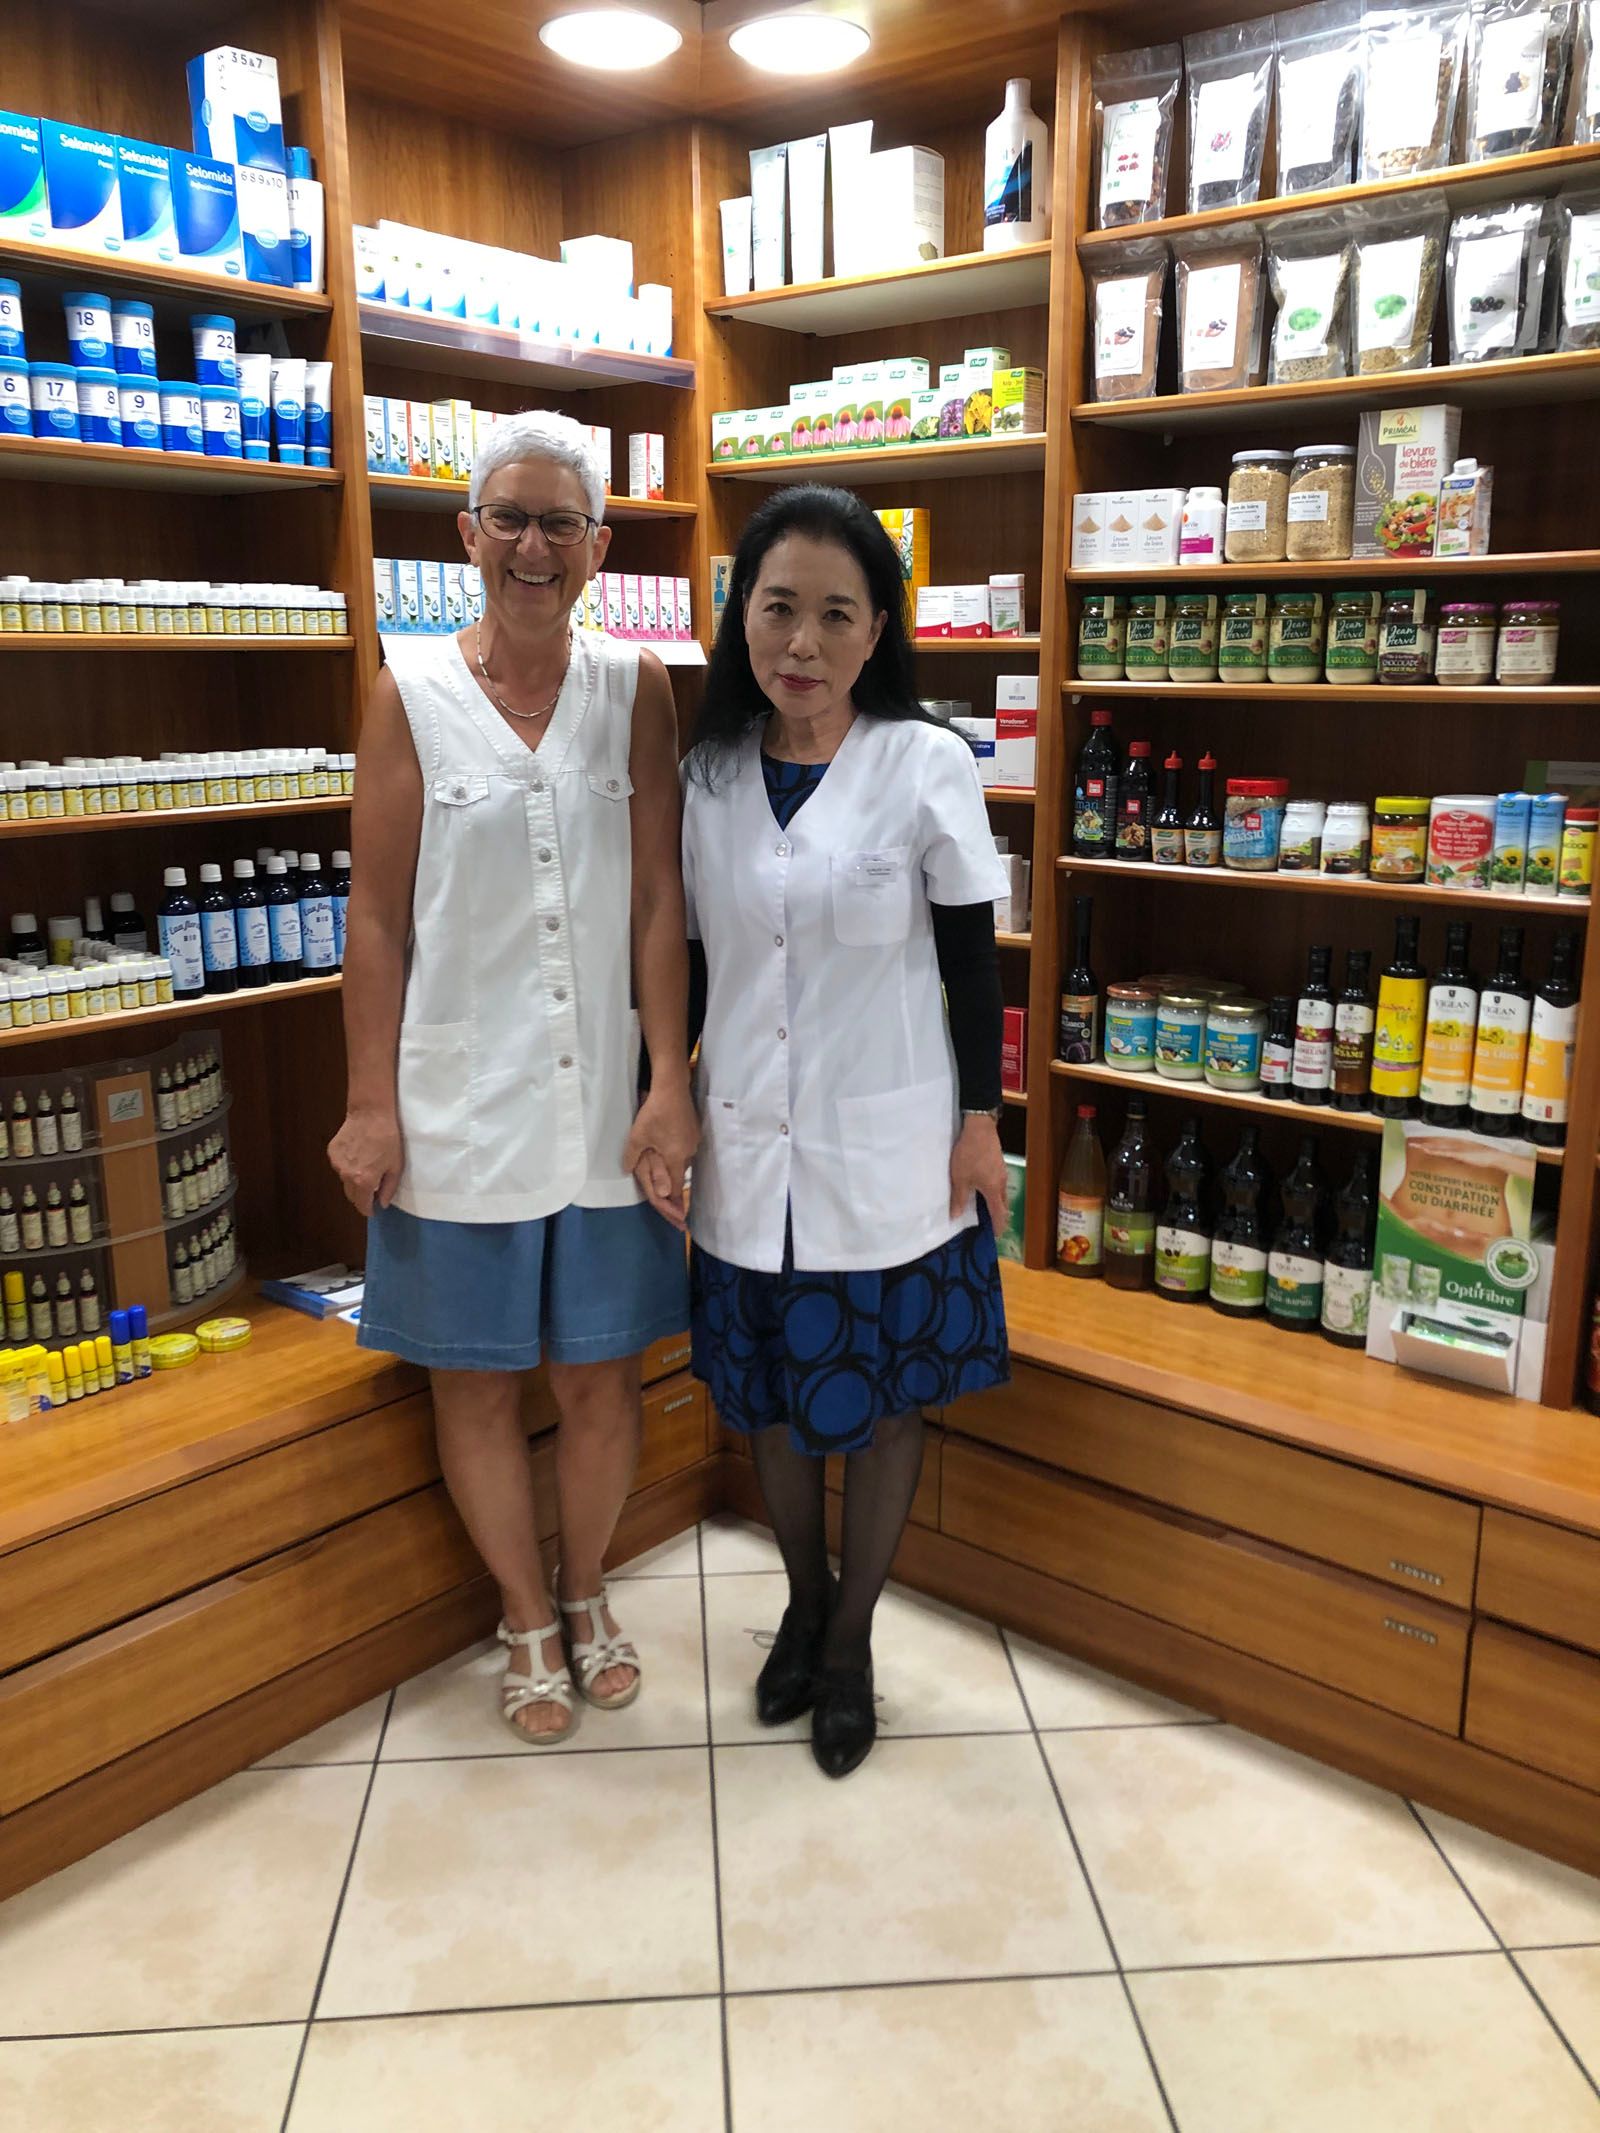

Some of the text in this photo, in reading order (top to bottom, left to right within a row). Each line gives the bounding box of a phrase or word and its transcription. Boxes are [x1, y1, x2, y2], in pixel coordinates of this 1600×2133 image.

[0, 123, 39, 142] omida
[186, 162, 232, 185] Selomida
[76, 311, 95, 326] 18
[135, 321, 151, 337] 19
[217, 334, 233, 350] 22
[4, 377, 15, 392] 6
[46, 381, 64, 397] 17
[107, 390, 116, 405] 8
[134, 394, 145, 409] 9
[224, 405, 238, 420] 21
[1402, 446, 1436, 458] levure
[1409, 456, 1437, 469] bière
[1408, 1179, 1499, 1206] CONSTIPATION
[1411, 1192, 1495, 1218] OU DIARRHÉE
[1445, 1280, 1516, 1308] OptiFibre
